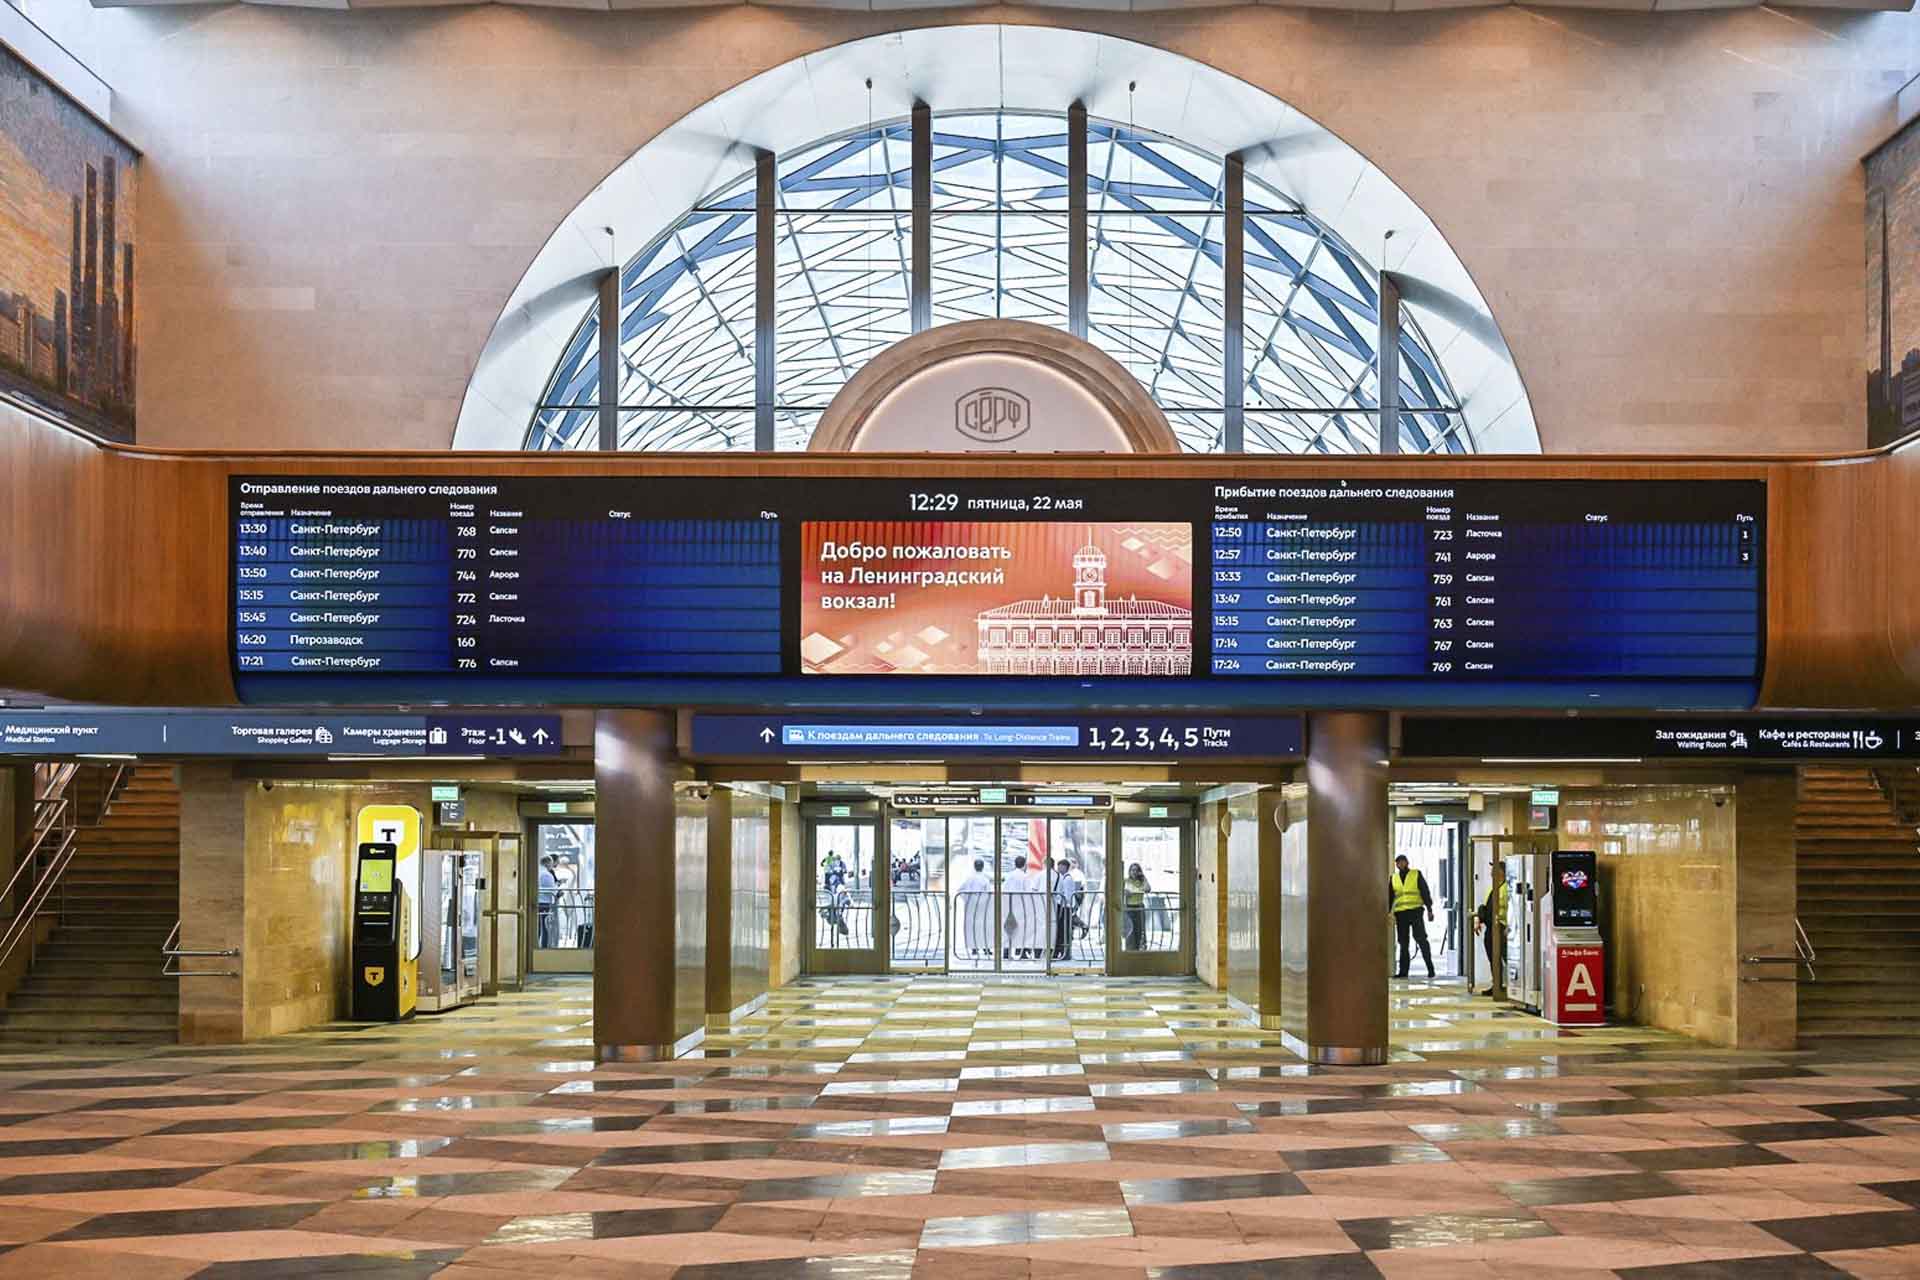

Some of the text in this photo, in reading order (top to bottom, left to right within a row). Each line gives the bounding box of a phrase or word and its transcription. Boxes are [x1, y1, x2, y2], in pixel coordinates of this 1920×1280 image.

[240, 483, 498, 495] Отправление поездов дальнего следования
[1214, 486, 1454, 499] Прибытие поездов дальнего следования
[909, 494, 959, 510] 12:29
[967, 497, 1083, 511] пятница, 22 мая
[760, 511, 778, 519] Путь
[1584, 514, 1608, 522] Статус
[1736, 514, 1754, 522] Путь
[239, 524, 268, 533] 13:30
[290, 524, 381, 535] Санкт-Петербург
[457, 527, 477, 536] 768
[489, 526, 518, 534] Сапсан
[1214, 528, 1242, 537] 12:50
[1266, 528, 1357, 539] Санкт-Петербург
[1433, 531, 1453, 540] 723
[1743, 530, 1749, 539] 1
[239, 546, 267, 555] 13:40
[290, 546, 380, 558] Санкт-Петербург
[456, 549, 477, 558] 770
[489, 548, 518, 556] Сапсан
[820, 542, 1015, 562] Добро пожаловать
[1214, 550, 1241, 559] 12:57
[1266, 550, 1357, 561] Санкт-Петербург
[1434, 553, 1452, 562] 741
[1465, 552, 1496, 560] Аврора
[1742, 552, 1750, 561] 3
[239, 568, 267, 577] 13:50
[290, 568, 380, 580] Санкт-Петербург
[456, 571, 476, 580] 744
[488, 571, 520, 579] Аврора
[821, 567, 1005, 587] на Ленинградский
[1215, 572, 1241, 581] 13:33
[1266, 572, 1357, 583] Санкт-Петербург
[1433, 574, 1453, 584] 759
[239, 590, 264, 600] 15:15
[290, 591, 380, 602] Санкт-Петербург
[457, 593, 476, 602] 772
[1214, 594, 1241, 603] 13:47
[821, 593, 896, 608] вокзал!
[1266, 594, 1357, 606] Санкт-Петербург
[1434, 597, 1452, 606] 761
[239, 613, 267, 622] 15:45
[289, 613, 380, 624] Санкт-Петербург
[456, 615, 477, 624] 724
[1214, 616, 1239, 625] 15:15
[1266, 616, 1357, 628] Санкт-Петербург
[1433, 619, 1453, 628] 763
[239, 635, 267, 644] 16:20
[290, 635, 364, 646] Петрозаводск
[457, 638, 476, 647] 160
[1214, 638, 1238, 647] 17:14
[1465, 640, 1494, 648] Сапсан
[1266, 639, 1356, 650] Санкт-Петербург
[1434, 641, 1453, 650] 767
[240, 656, 264, 665] 17:21
[291, 656, 381, 667] Санкт-Петербург
[457, 659, 477, 668] 776
[1214, 660, 1240, 669] 17:24
[1265, 660, 1356, 671] Санкт-Петербург
[1432, 663, 1452, 671] 769
[4, 726, 99, 736] Медицинский пункт
[231, 727, 275, 736] Торговая
[343, 728, 427, 737] Камеры хранения
[461, 728, 486, 736] Этаж
[1202, 728, 1231, 740] Пути
[1655, 730, 1727, 740] Зал ожидания
[1759, 729, 1850, 742] Кафе и рестораны
[488, 728, 507, 744] -1
[808, 730, 979, 742] К поездам дальнего следования
[1089, 728, 1199, 750] 1, 2, 3, 4, 5
[1676, 741, 1705, 749] Waiting
